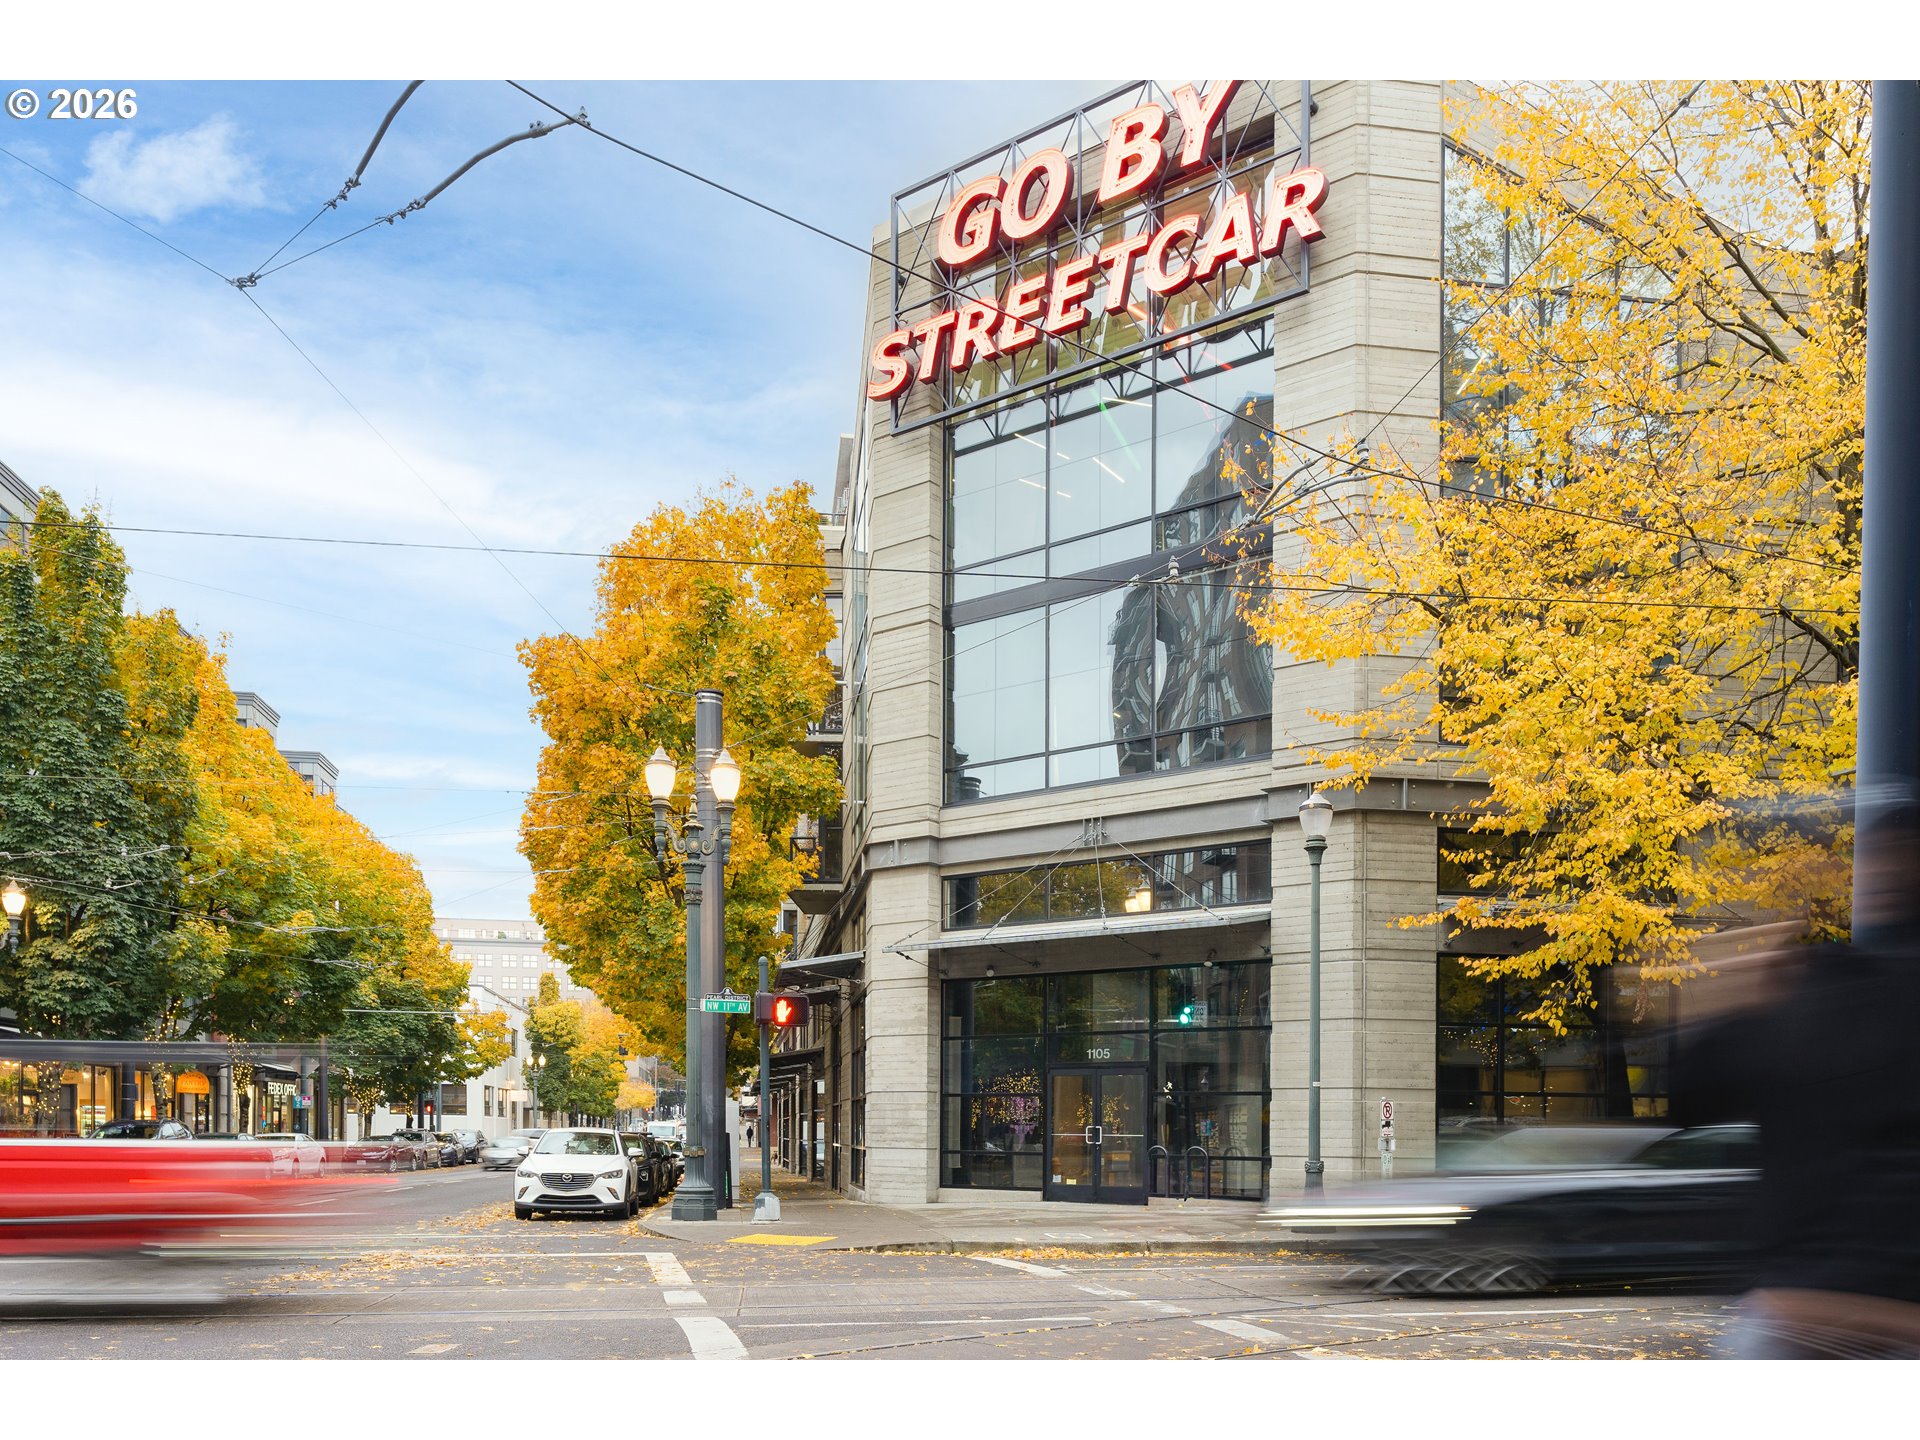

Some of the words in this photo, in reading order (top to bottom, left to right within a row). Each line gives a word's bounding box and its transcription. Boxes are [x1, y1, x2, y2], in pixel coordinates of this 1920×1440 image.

[937, 147, 1074, 267] GO
[1098, 80, 1243, 203] BY
[866, 166, 1331, 401] STREETCAR
[706, 1001, 719, 1011] NW
[737, 1002, 748, 1012] AV
[1086, 1048, 1111, 1059] 1105
[267, 1082, 284, 1095] FEDEX
